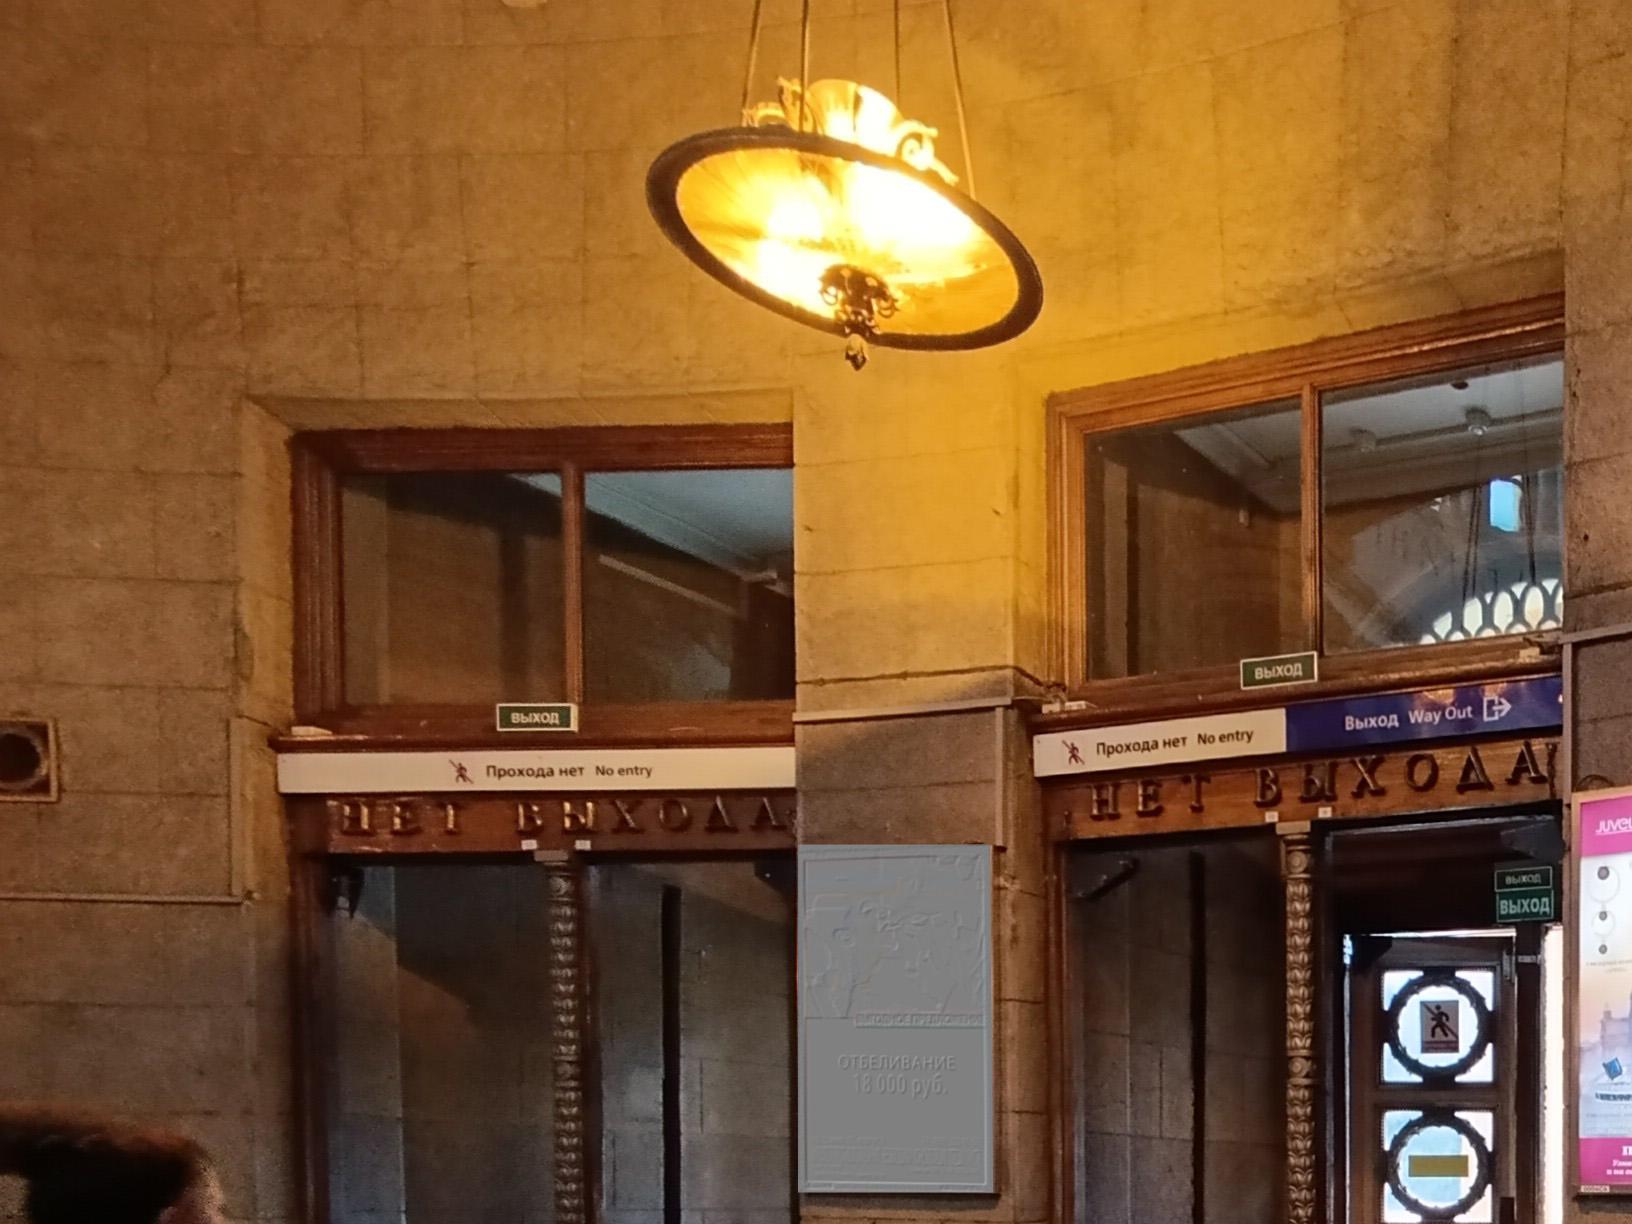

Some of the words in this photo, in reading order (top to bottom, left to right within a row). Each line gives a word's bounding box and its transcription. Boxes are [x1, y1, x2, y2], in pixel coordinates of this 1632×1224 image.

[1254, 661, 1303, 681] ВЫХОД
[510, 710, 561, 726] ВЫХОД
[1344, 712, 1399, 731] Выход
[1408, 707, 1442, 727] Way
[1444, 705, 1473, 722] Out
[1096, 736, 1160, 757] Прохода
[1162, 734, 1188, 749] нет
[1196, 731, 1216, 746] No
[1218, 727, 1254, 746] entry
[485, 764, 555, 781] Прохода
[558, 765, 585, 778] нет
[595, 764, 615, 778] No
[617, 764, 653, 781] entry
[1091, 774, 1212, 821] НЕТ
[1254, 740, 1549, 808] ВЫХОДА
[342, 801, 461, 835] НЕТ
[516, 795, 791, 834] ВЫХОДА
[1505, 873, 1542, 886] ВЫХОД
[1499, 896, 1551, 916] ВЫХОД
[838, 1054, 957, 1072] ОТБЕЛИВАНИЕ
[853, 1074, 872, 1095] 18
[876, 1074, 907, 1095] 000
[911, 1073, 949, 1099] руб.
